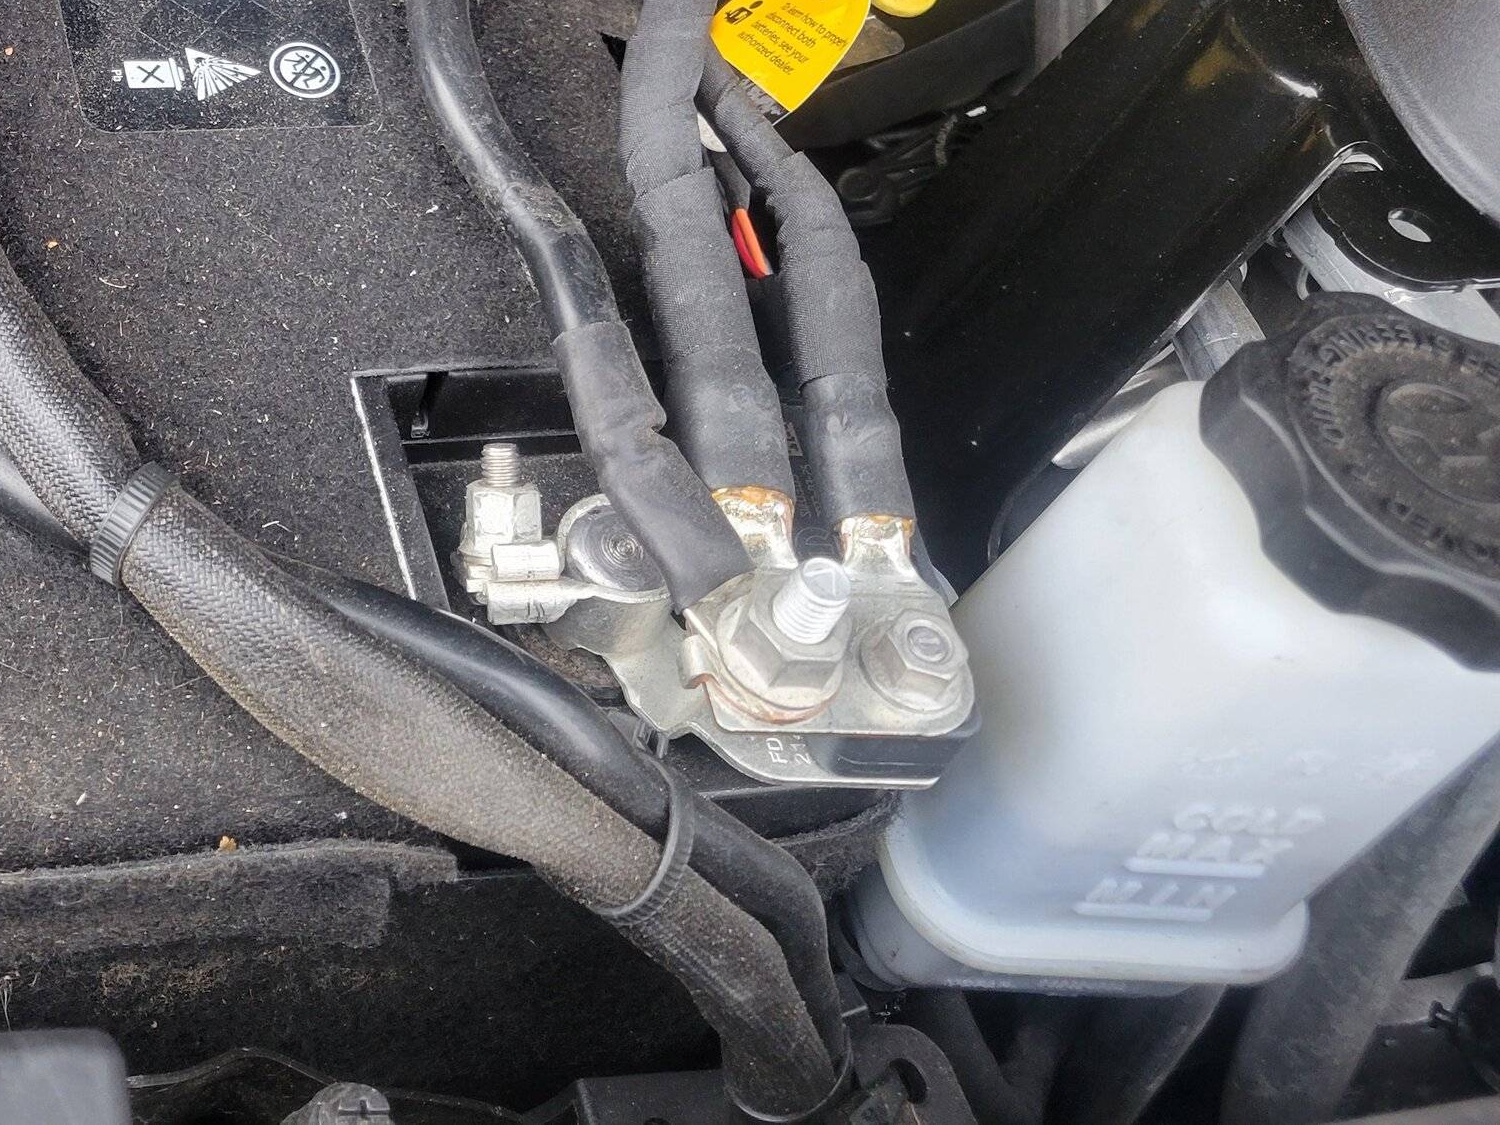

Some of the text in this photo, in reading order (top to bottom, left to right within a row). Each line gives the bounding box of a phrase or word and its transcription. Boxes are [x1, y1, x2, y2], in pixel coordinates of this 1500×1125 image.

[801, 14, 819, 28] how
[817, 23, 828, 35] to
[779, 40, 793, 53] see
[790, 49, 809, 65] your
[796, 32, 817, 50] both
[111, 68, 122, 83] Pb
[1172, 802, 1326, 837] COLD
[1136, 831, 1295, 863] MAX
[1085, 876, 1238, 908] MIN
